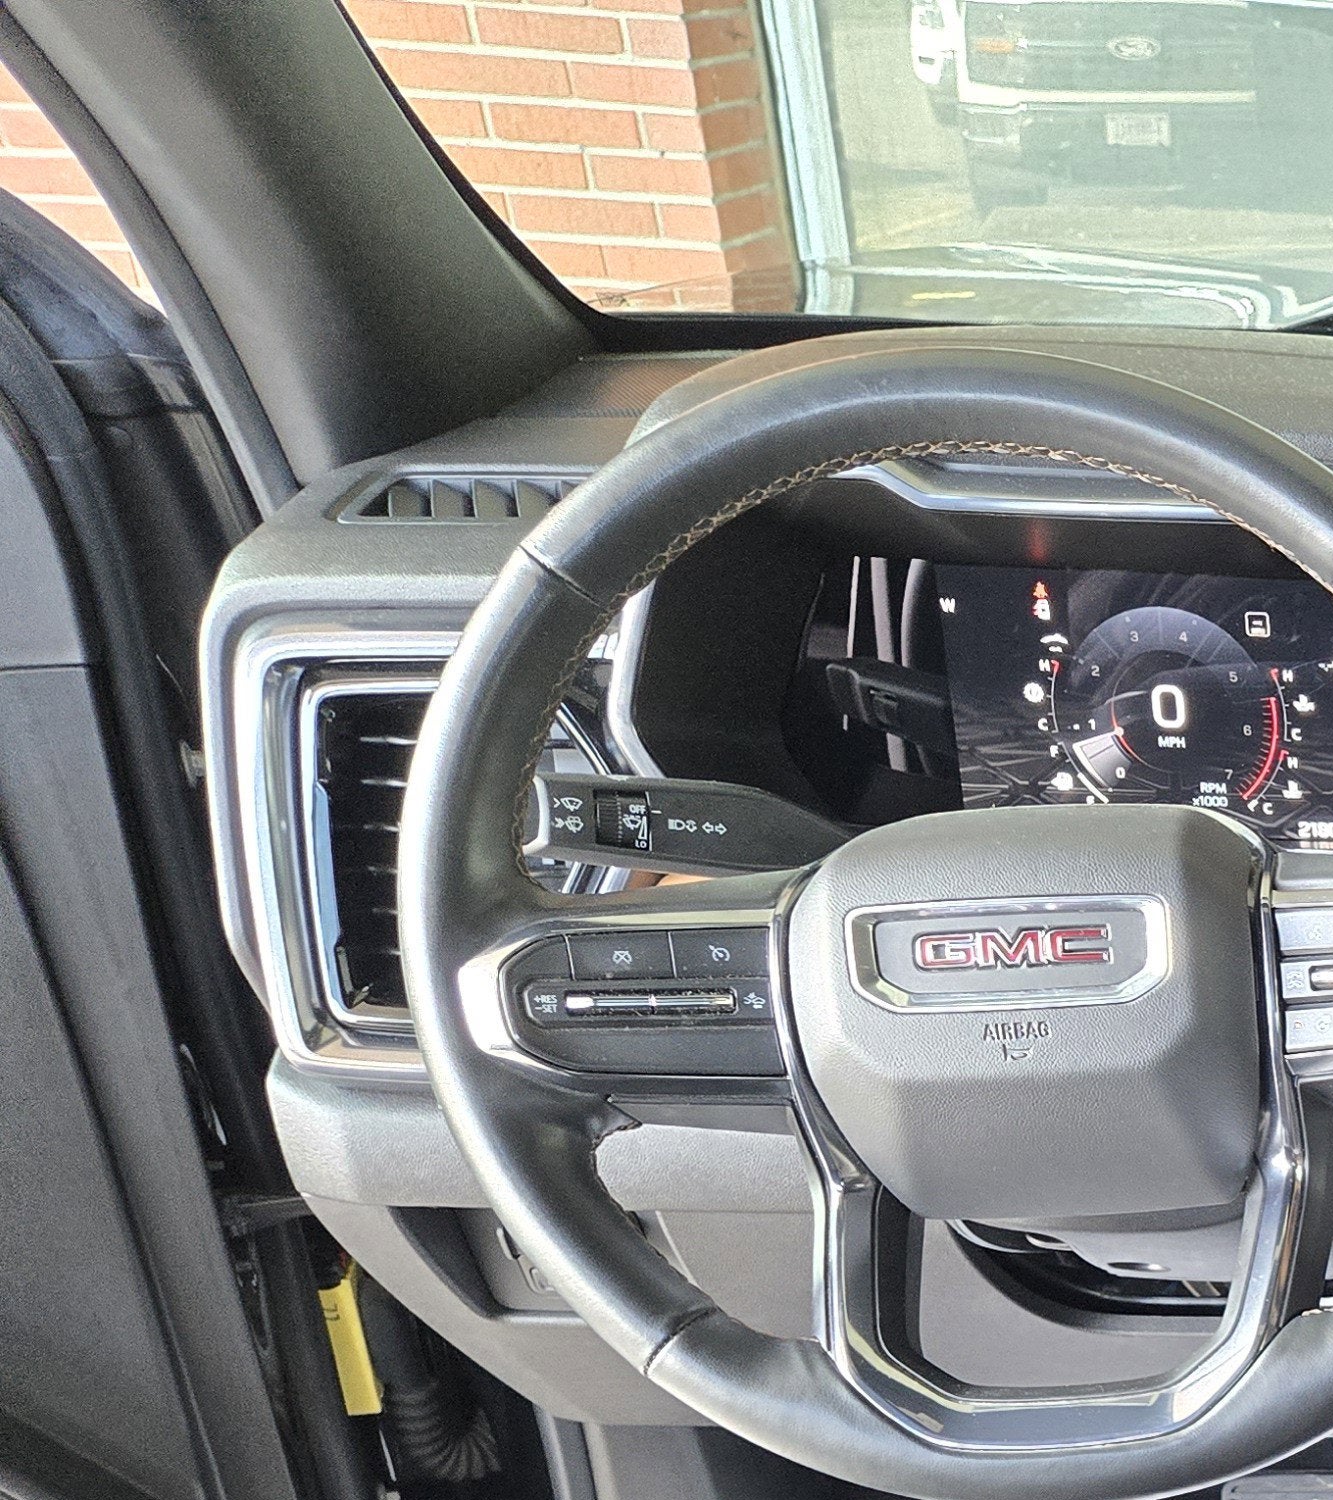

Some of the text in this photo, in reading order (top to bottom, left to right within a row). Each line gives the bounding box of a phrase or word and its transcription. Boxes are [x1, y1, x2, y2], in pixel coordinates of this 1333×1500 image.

[938, 597, 956, 613] W
[1129, 630, 1139, 643] 3
[1178, 630, 1188, 643] 4
[1091, 665, 1101, 677] 2
[1228, 671, 1239, 683] 5
[1281, 669, 1293, 682] H
[1151, 684, 1185, 729] 0
[1243, 724, 1252, 737] 6
[1291, 728, 1302, 741] C
[1157, 735, 1187, 749] MPH
[1224, 769, 1234, 780] 7
[1200, 782, 1227, 795] RPM
[628, 804, 646, 814] OFF
[915, 923, 1114, 970] GMC
[982, 1021, 1049, 1041] AIRBAG
